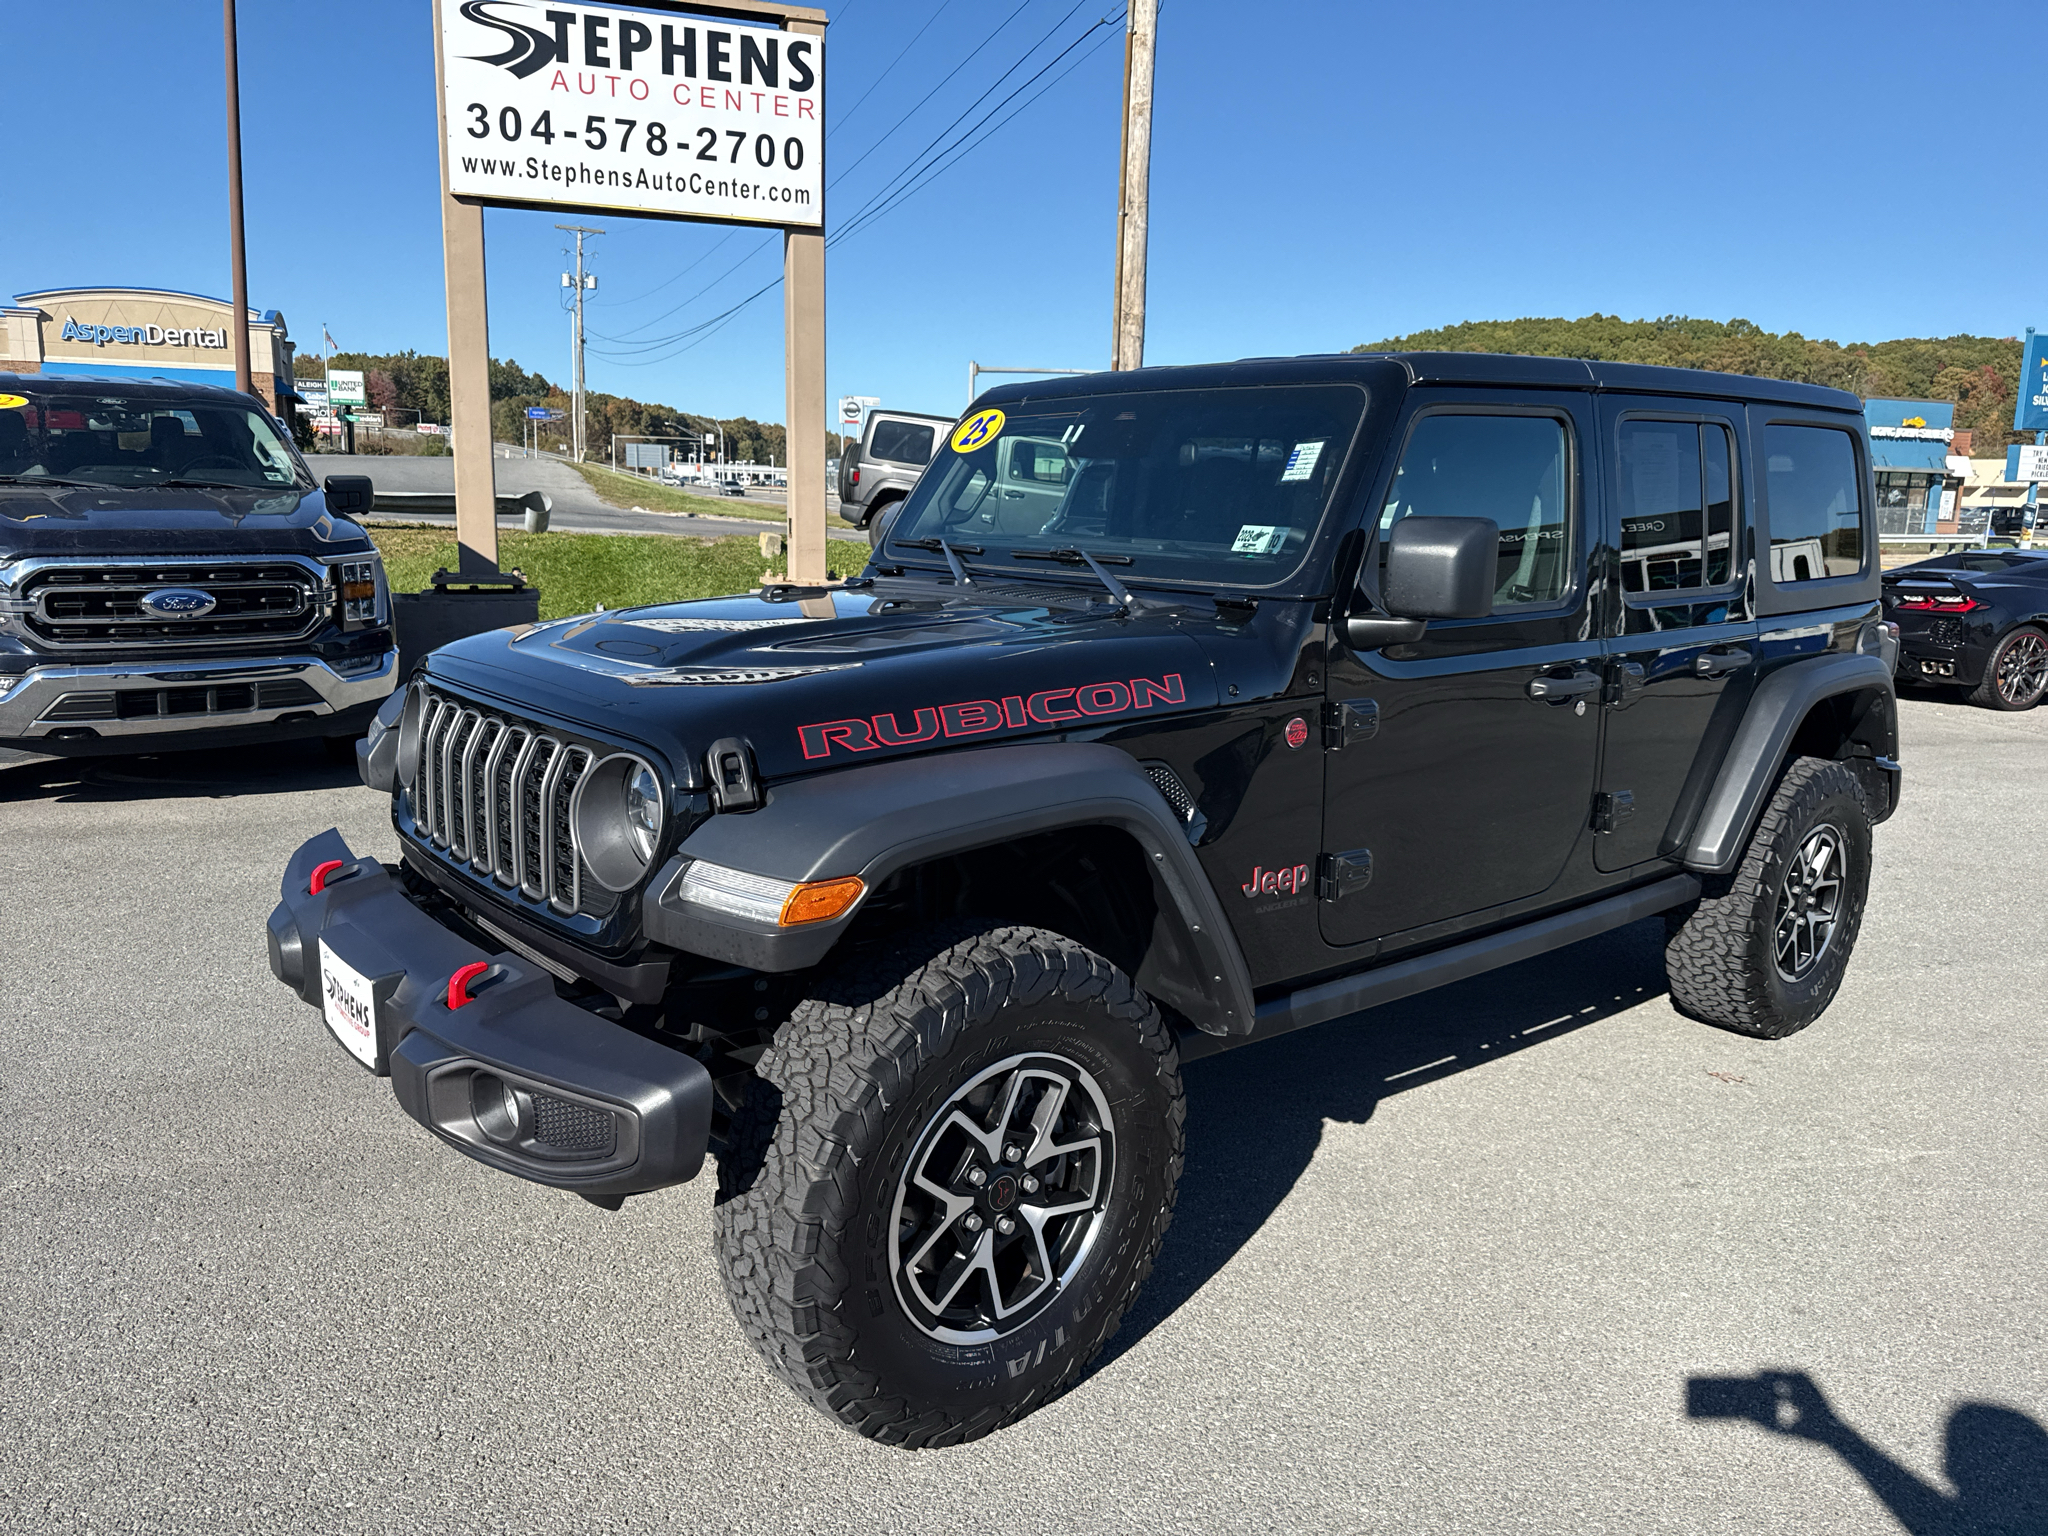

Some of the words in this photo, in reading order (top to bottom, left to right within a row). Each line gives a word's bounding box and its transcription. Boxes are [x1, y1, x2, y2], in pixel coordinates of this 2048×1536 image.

[452, 0, 815, 92] STEPHENS
[550, 70, 650, 101] AUTO
[673, 83, 815, 120] CENTER
[466, 102, 804, 170] 304-578-2700
[461, 156, 811, 205] www.StephensAutoCenter.com
[61, 317, 227, 349] AspenDental
[297, 380, 323, 388] ALEIGH
[338, 380, 363, 388] UNITED
[958, 414, 998, 447] 25
[1267, 534, 1281, 549] 10
[162, 596, 198, 609] Ford
[797, 673, 1186, 760] RUBICON
[1241, 863, 1310, 899] Jeep
[324, 968, 369, 1028] STEPHENS
[354, 1023, 370, 1039] GROUP
